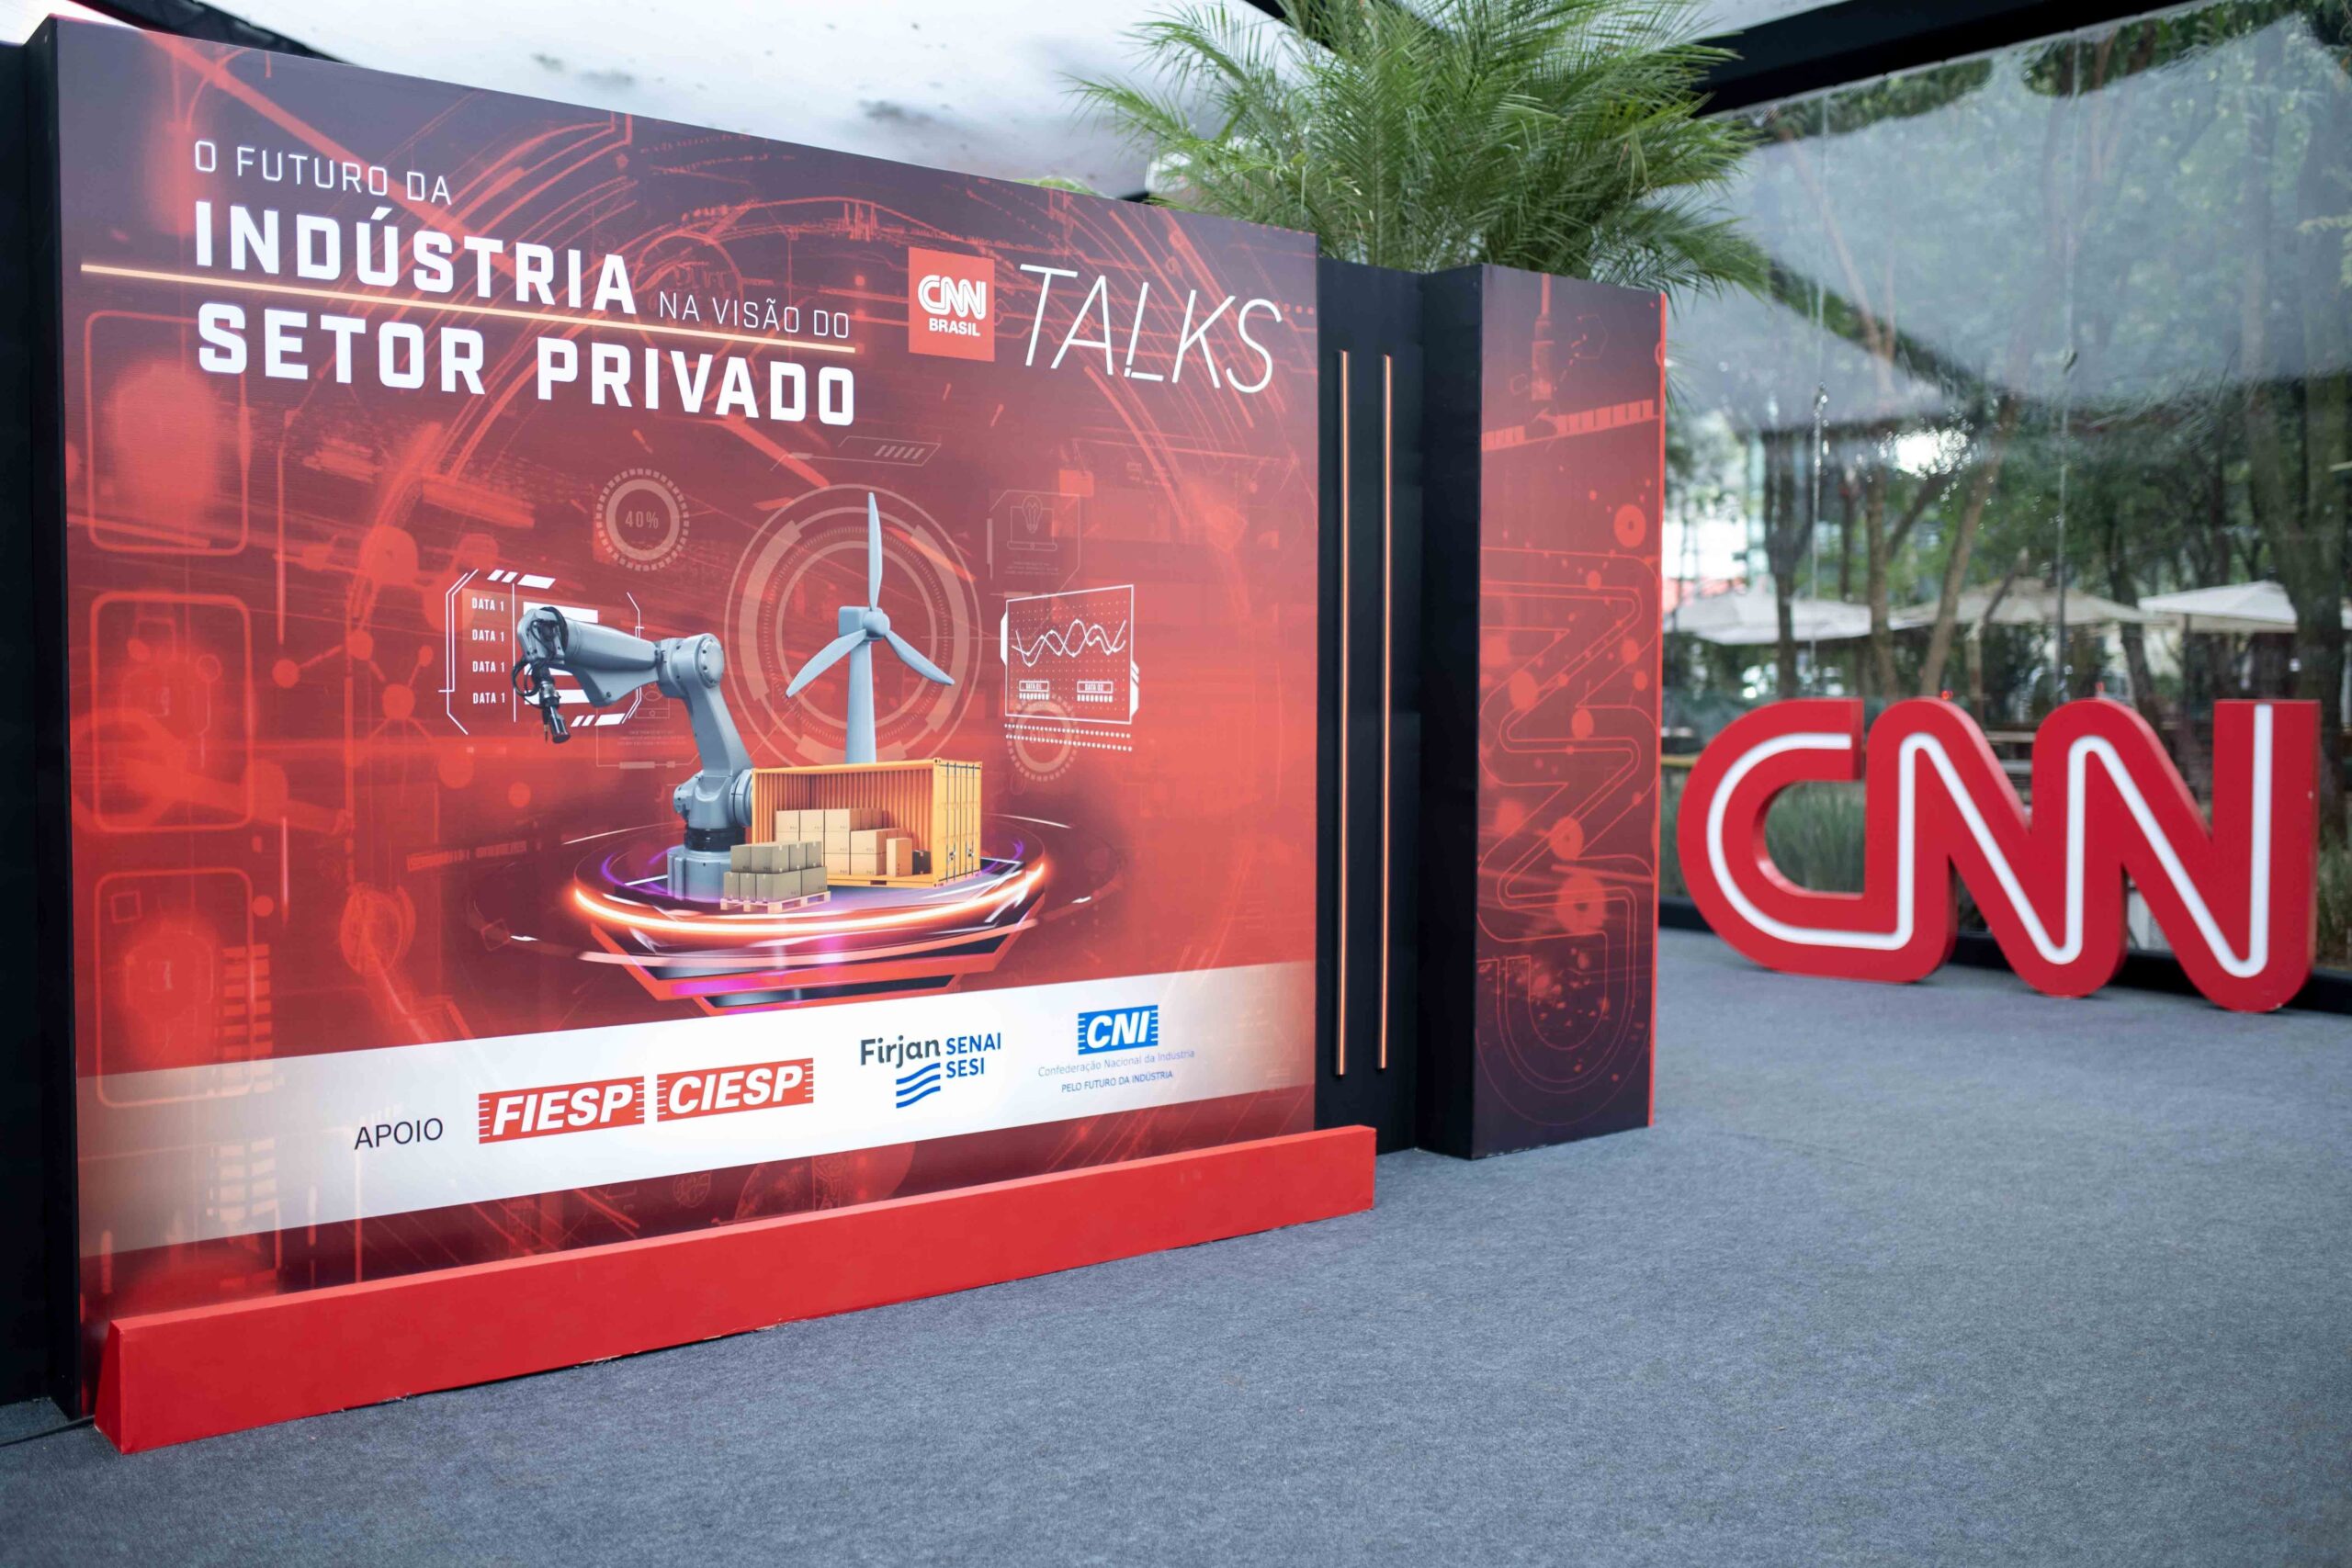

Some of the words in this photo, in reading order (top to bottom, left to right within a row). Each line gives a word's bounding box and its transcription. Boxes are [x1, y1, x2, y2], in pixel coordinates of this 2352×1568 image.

[195, 140, 218, 173] O
[236, 146, 389, 197] FUTURO
[406, 169, 453, 206] DA
[194, 199, 638, 314] INDÚSTRIA
[659, 290, 700, 322] NA
[712, 298, 800, 333] VISÃO
[813, 309, 850, 339] DO
[917, 274, 987, 321] CNN
[928, 317, 981, 337] BRASIL
[1019, 263, 1283, 394] TALKS
[198, 301, 486, 395] SETOR
[537, 335, 855, 427] PRIVADO
[625, 510, 660, 529] 40%
[471, 597, 495, 611] DATA
[500, 601, 504, 612] 1
[471, 629, 496, 642] DATA
[500, 631, 504, 642] 1
[472, 660, 496, 673] DATA
[501, 661, 505, 673] 1
[472, 692, 497, 705] DATA
[501, 692, 505, 704] 1
[1677, 696, 2322, 1014] CNN
[945, 1032, 1002, 1055] SENAI
[1086, 1010, 1151, 1050] CNI
[860, 1034, 941, 1069] Firjan
[945, 1057, 985, 1079] SESI
[1038, 1061, 1102, 1077] Confederação
[1104, 1056, 1142, 1069] Nacional
[1145, 1054, 1155, 1064] da
[668, 1064, 804, 1114] CIESP
[1061, 1082, 1082, 1093] PELO
[1084, 1077, 1116, 1091] FUTURO
[1118, 1076, 1130, 1086] DA
[492, 1083, 634, 1136] FIESP
[354, 1117, 444, 1151] APOIO
